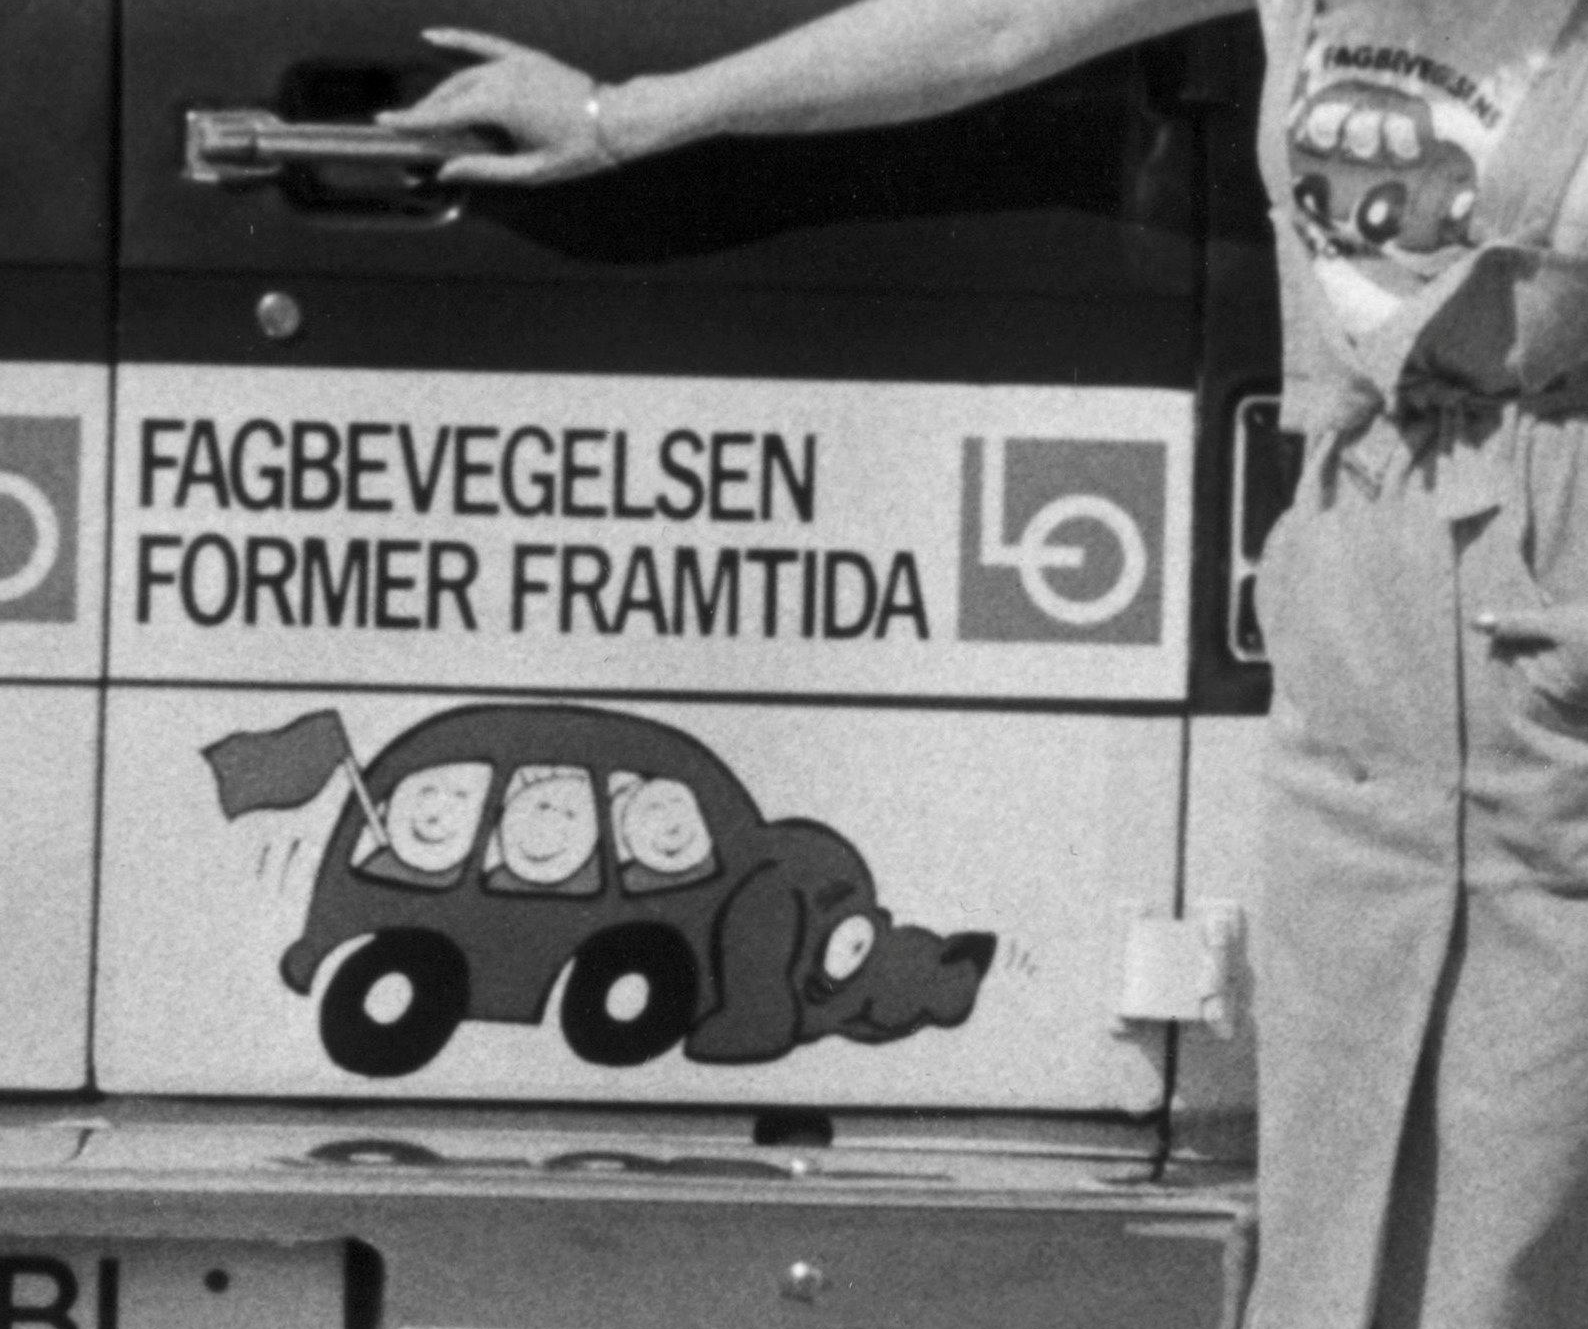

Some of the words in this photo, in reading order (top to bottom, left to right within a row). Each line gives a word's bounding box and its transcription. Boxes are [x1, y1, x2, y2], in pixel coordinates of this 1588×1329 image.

[136, 416, 819, 525] FAGBEVEGELSEN
[134, 533, 480, 632] FORMER
[510, 543, 931, 642] FRAMTIDA
